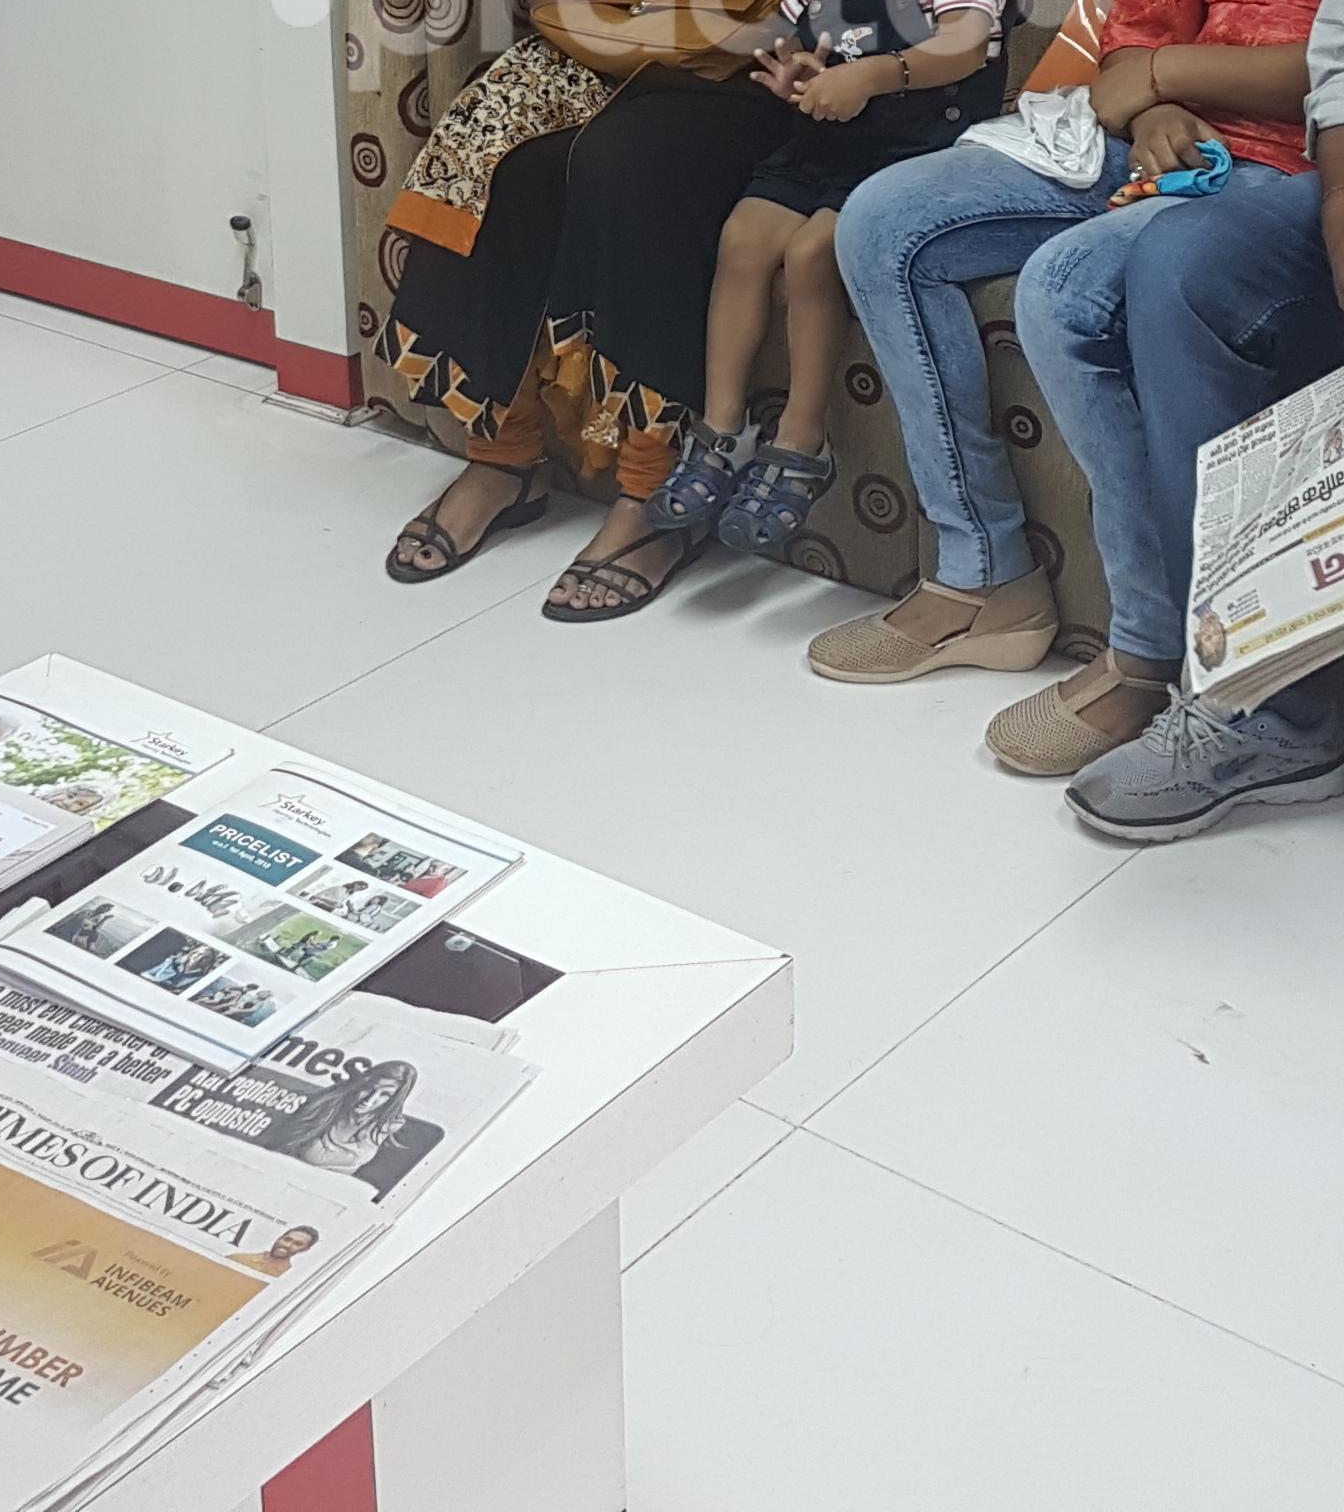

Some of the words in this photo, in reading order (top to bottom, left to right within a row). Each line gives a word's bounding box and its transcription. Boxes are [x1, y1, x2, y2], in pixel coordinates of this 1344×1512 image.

[148, 737, 186, 757] Starkey
[280, 801, 326, 826] Starkey
[209, 824, 303, 868] PRICELIST
[25, 1024, 78, 1051] made
[69, 1040, 103, 1061] me
[111, 1052, 173, 1084] better
[162, 1085, 199, 1112] PC
[191, 1096, 272, 1137] opposite
[224, 1075, 307, 1114] replaces
[78, 1153, 144, 1200] OF
[134, 1173, 258, 1249] INDIA
[90, 1276, 172, 1317] AVENUES
[105, 1263, 193, 1309] INFIBEAM
